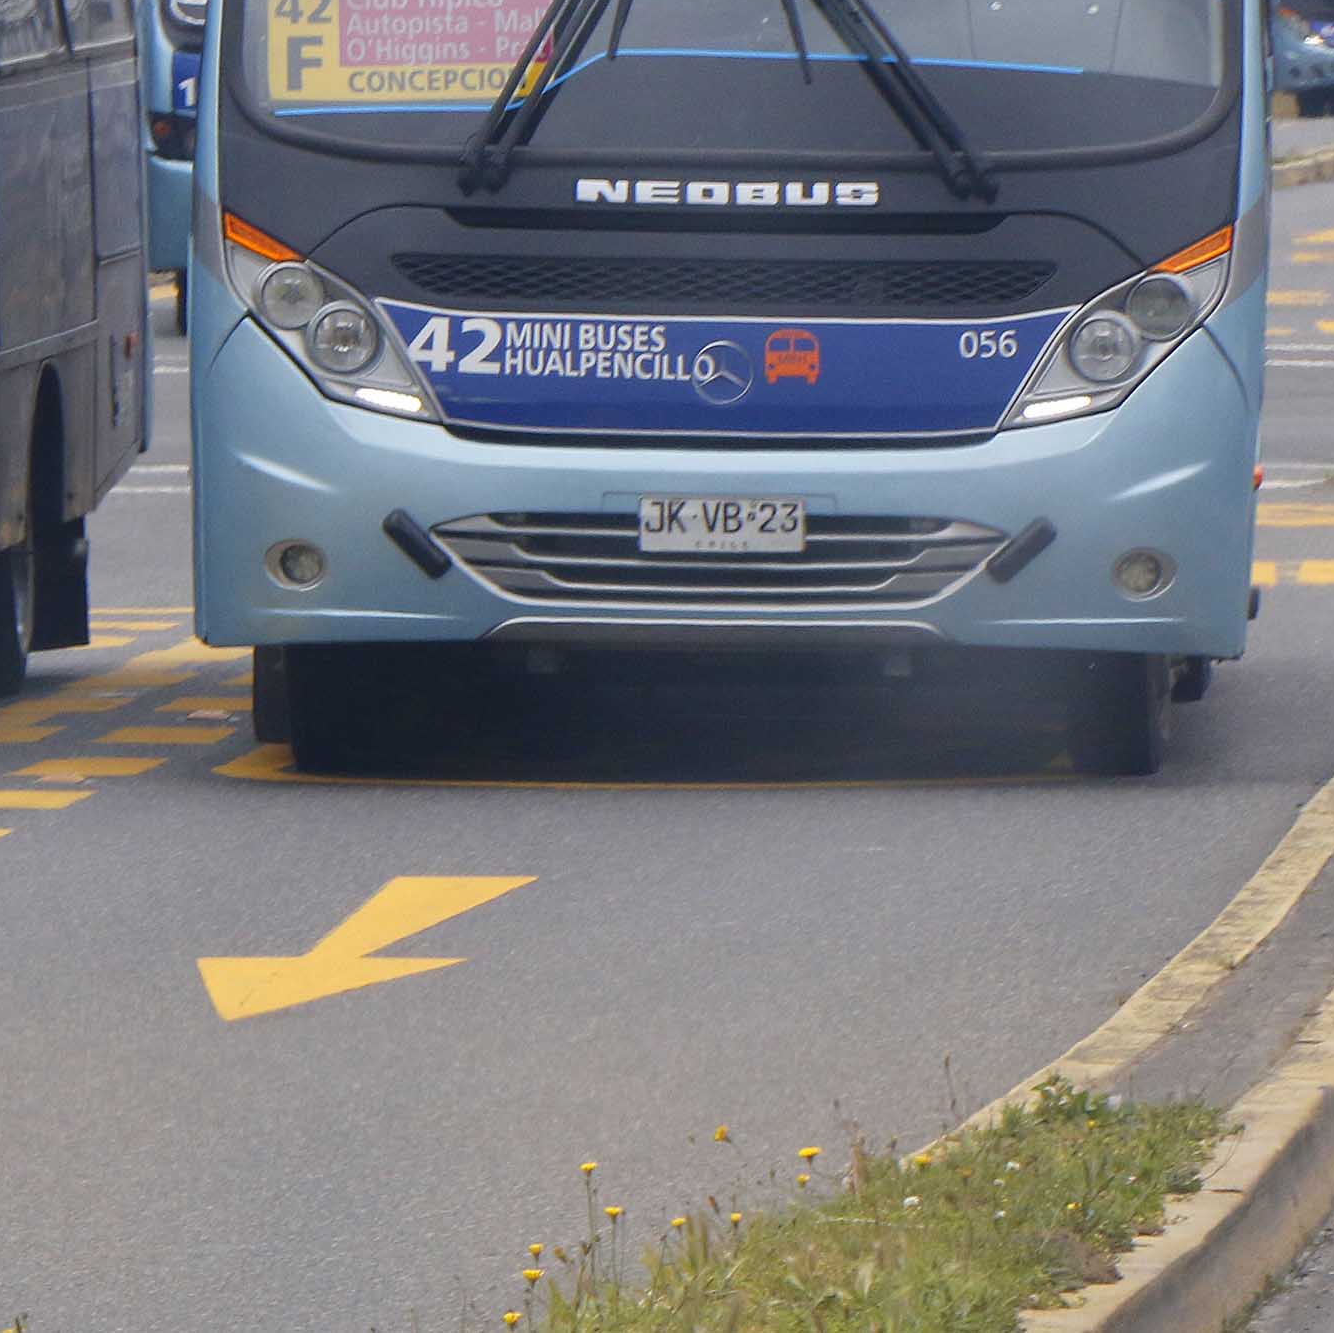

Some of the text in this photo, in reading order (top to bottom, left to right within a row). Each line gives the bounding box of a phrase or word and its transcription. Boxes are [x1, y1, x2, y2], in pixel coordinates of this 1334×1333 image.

[347, 12, 468, 37] Autopista
[287, 36, 323, 91] F
[576, 178, 879, 206] NEOBUS
[408, 316, 503, 375] 42
[505, 322, 667, 352] MINI BUSES
[960, 329, 1017, 358] 056
[504, 351, 715, 381] HUALPENCILLO
